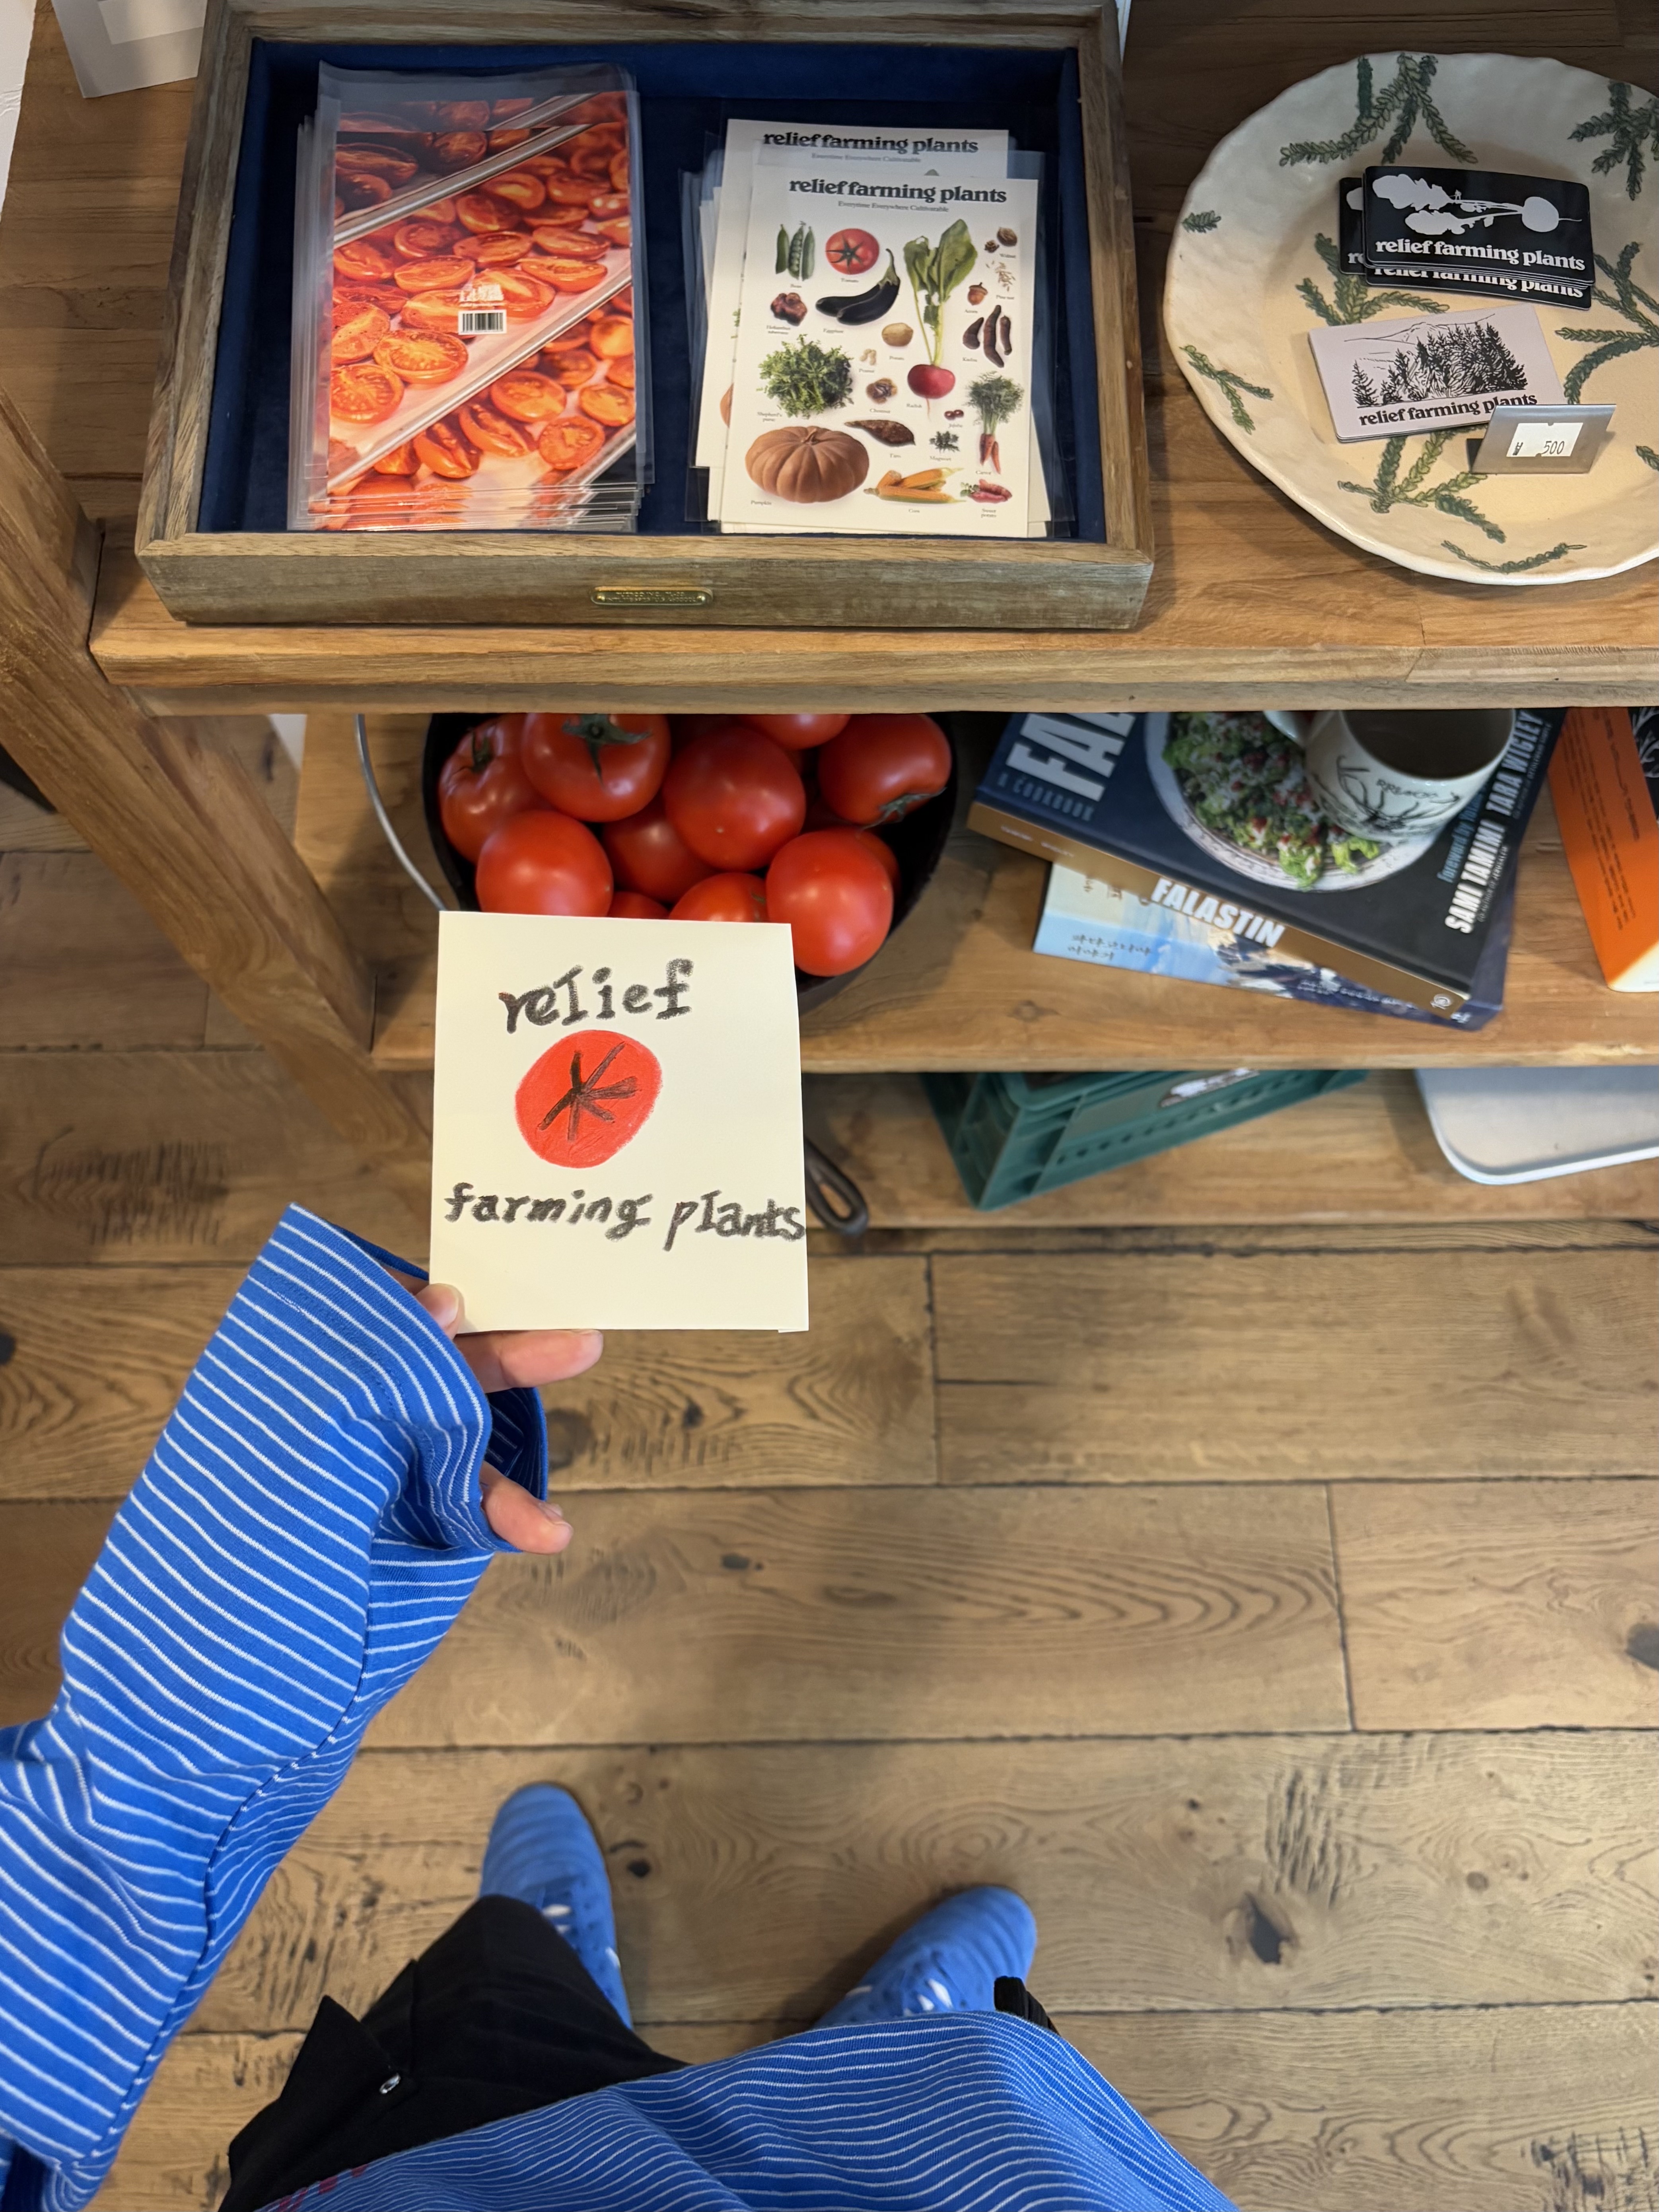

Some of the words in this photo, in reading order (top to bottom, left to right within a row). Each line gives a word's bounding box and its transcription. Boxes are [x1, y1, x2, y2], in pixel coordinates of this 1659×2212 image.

[763, 132, 822, 147] relief
[822, 134, 908, 154] farming
[912, 138, 978, 155] plants
[789, 179, 848, 195] relief
[848, 182, 936, 203] farming
[939, 186, 1007, 203] plants
[1375, 238, 1433, 254] relief
[1434, 241, 1519, 265] farming
[1523, 250, 1585, 270] plants
[1359, 409, 1406, 426] relief
[1407, 401, 1480, 420] farming
[1541, 440, 1565, 454] 500
[1501, 710, 1544, 773] WIGLEY
[1486, 771, 1523, 816] TARA
[1460, 818, 1506, 886] TAMIMI
[1150, 877, 1286, 948] FALASTIN
[1444, 881, 1484, 933] SAMI
[498, 958, 694, 1034] relief
[444, 1182, 653, 1241] farming
[663, 1190, 806, 1252] plants
